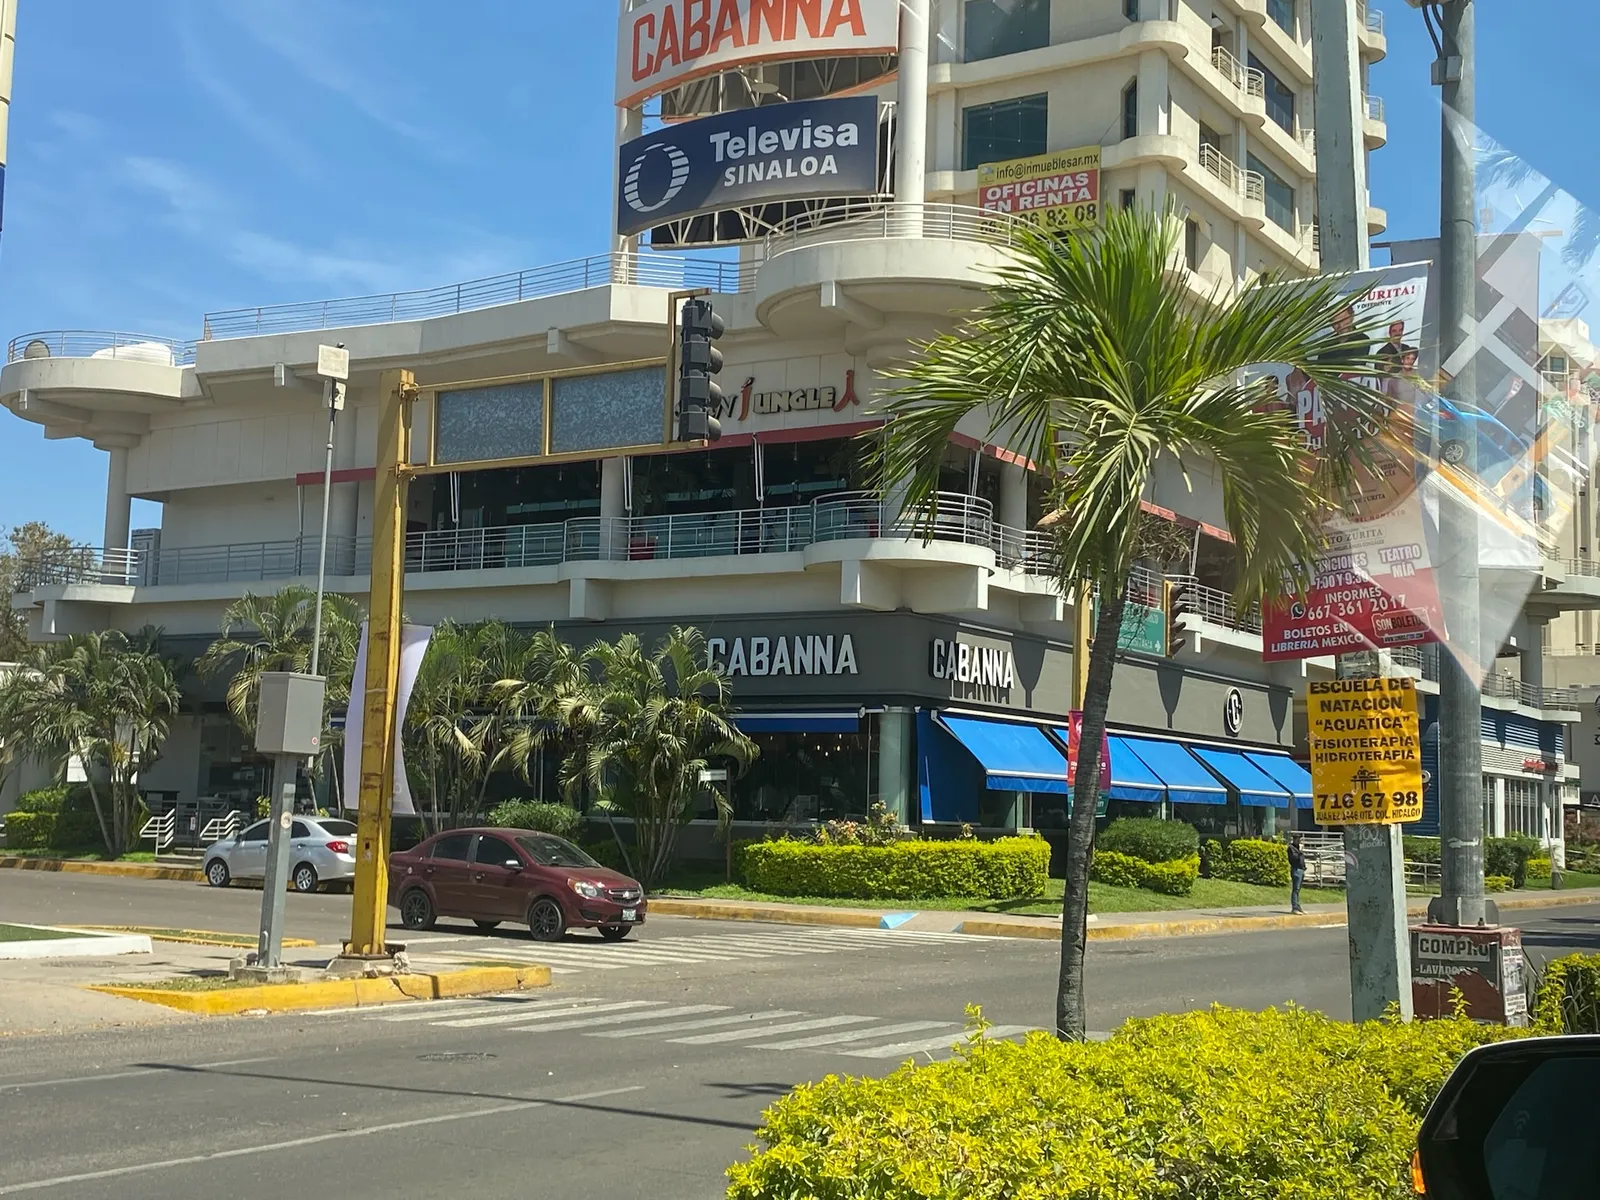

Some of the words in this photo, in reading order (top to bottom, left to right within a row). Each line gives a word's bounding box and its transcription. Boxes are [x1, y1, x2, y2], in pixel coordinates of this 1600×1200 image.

[632, 0, 867, 82] CABANNA
[710, 119, 859, 163] Televisa
[723, 154, 838, 188] SINALOA
[996, 153, 1099, 179] info@inmueblesar.mx
[986, 172, 1089, 201] OFICINAS
[983, 199, 1012, 217] EN
[1019, 187, 1092, 211] RENTA
[1074, 203, 1097, 222] 08
[1346, 529, 1383, 541] ZURITA
[1379, 545, 1421, 562] TEATRO
[1391, 561, 1415, 578] MÍA
[1336, 573, 1343, 586] Y
[1325, 587, 1382, 604] INFORMES
[1307, 605, 1330, 621] 667
[1338, 601, 1363, 617] 361
[1371, 594, 1407, 612] 2017
[1283, 624, 1331, 640] BOLETOS
[1333, 622, 1349, 634] EN
[1271, 636, 1319, 653] LIBRERIA
[1321, 632, 1364, 648] MEXICO
[707, 634, 859, 676] CABANNA
[932, 638, 1015, 689] CABANNA
[1310, 680, 1383, 694] ESCUELA
[1388, 678, 1410, 691] DE
[1320, 697, 1403, 713] NATACION
[1314, 736, 1414, 749] FISIOTERAPIA
[1315, 750, 1415, 762] HIDROTERAPIA
[1317, 792, 1354, 809] 716
[1361, 793, 1385, 808] 67
[1392, 791, 1418, 807] 98
[1316, 811, 1340, 820] JUAREZ
[1375, 810, 1390, 819] COL.
[1392, 808, 1421, 818] HIDALGO
